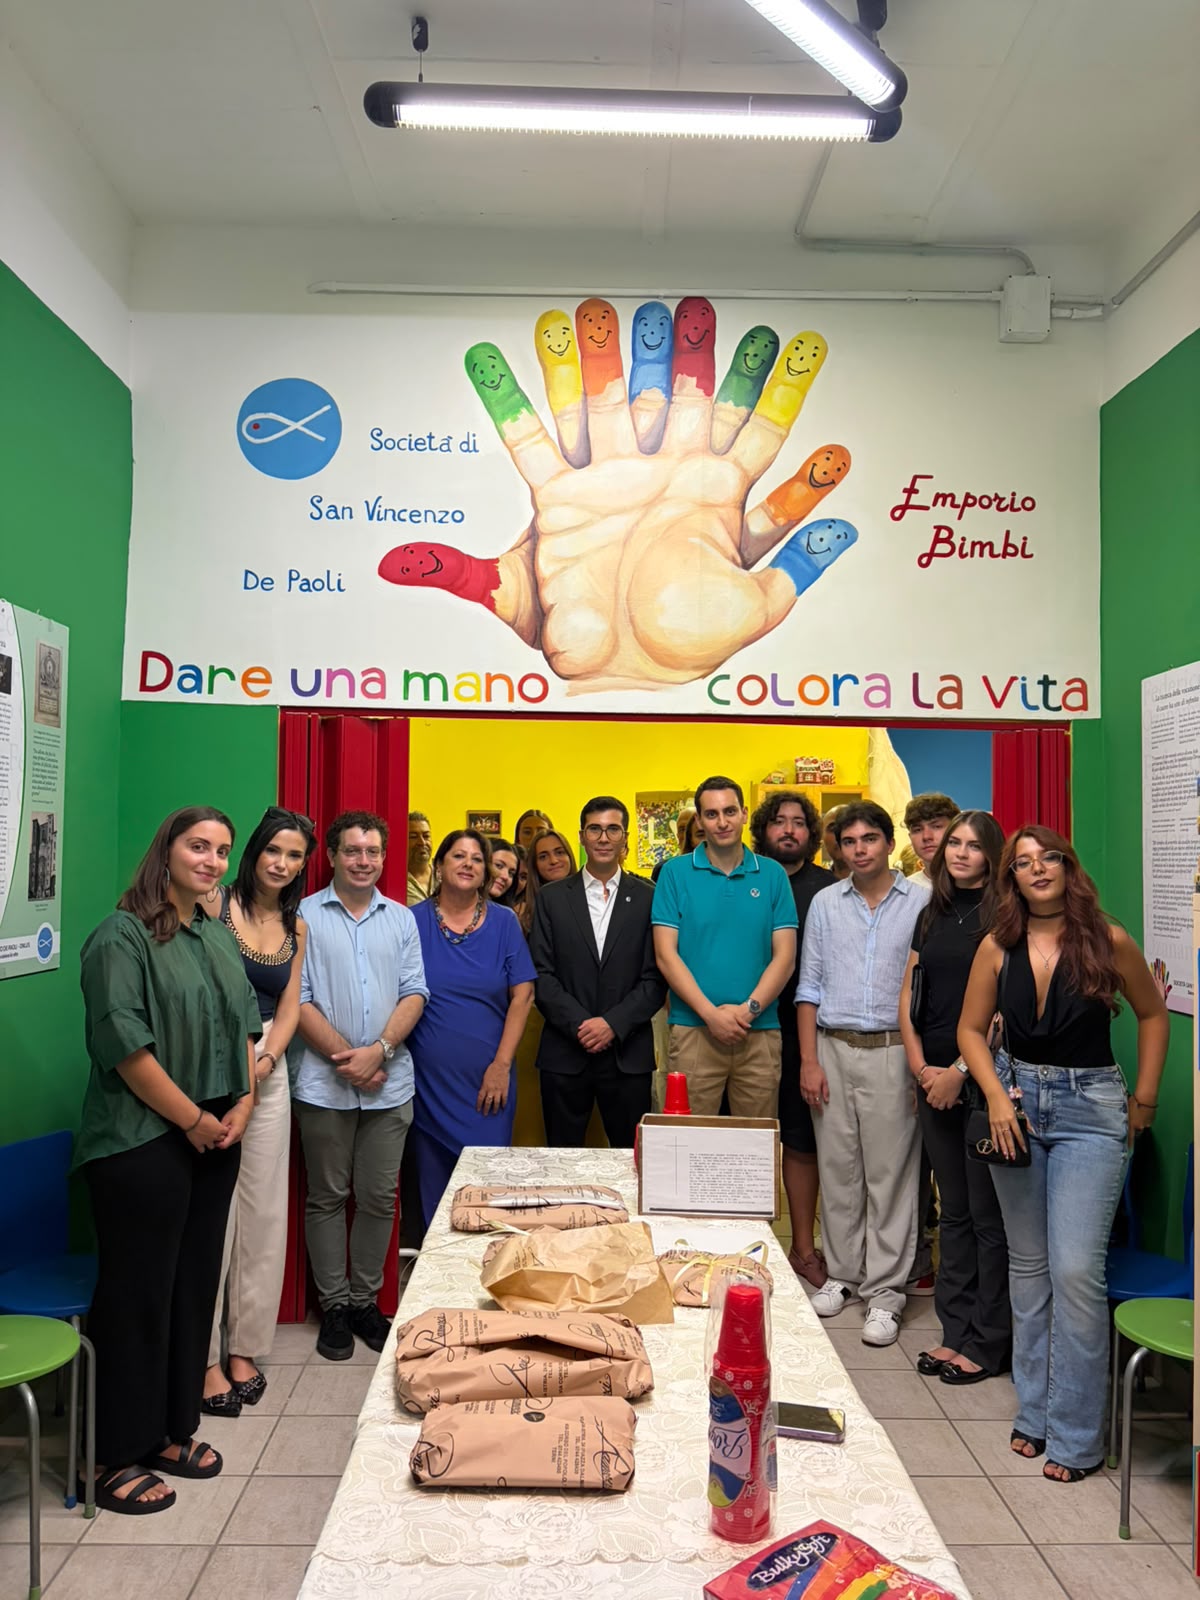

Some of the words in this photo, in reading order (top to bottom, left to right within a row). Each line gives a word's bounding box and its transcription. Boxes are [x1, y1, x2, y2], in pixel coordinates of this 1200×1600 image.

[459, 431, 480, 453] di
[309, 495, 354, 521] San
[364, 495, 465, 523] Vincenzo
[889, 474, 1037, 522] Emporio
[917, 524, 1034, 569] Bimbi
[243, 569, 275, 591] De
[287, 569, 346, 592] Paoli
[138, 650, 273, 699] Dare
[290, 666, 387, 701] una
[402, 668, 549, 704] mano
